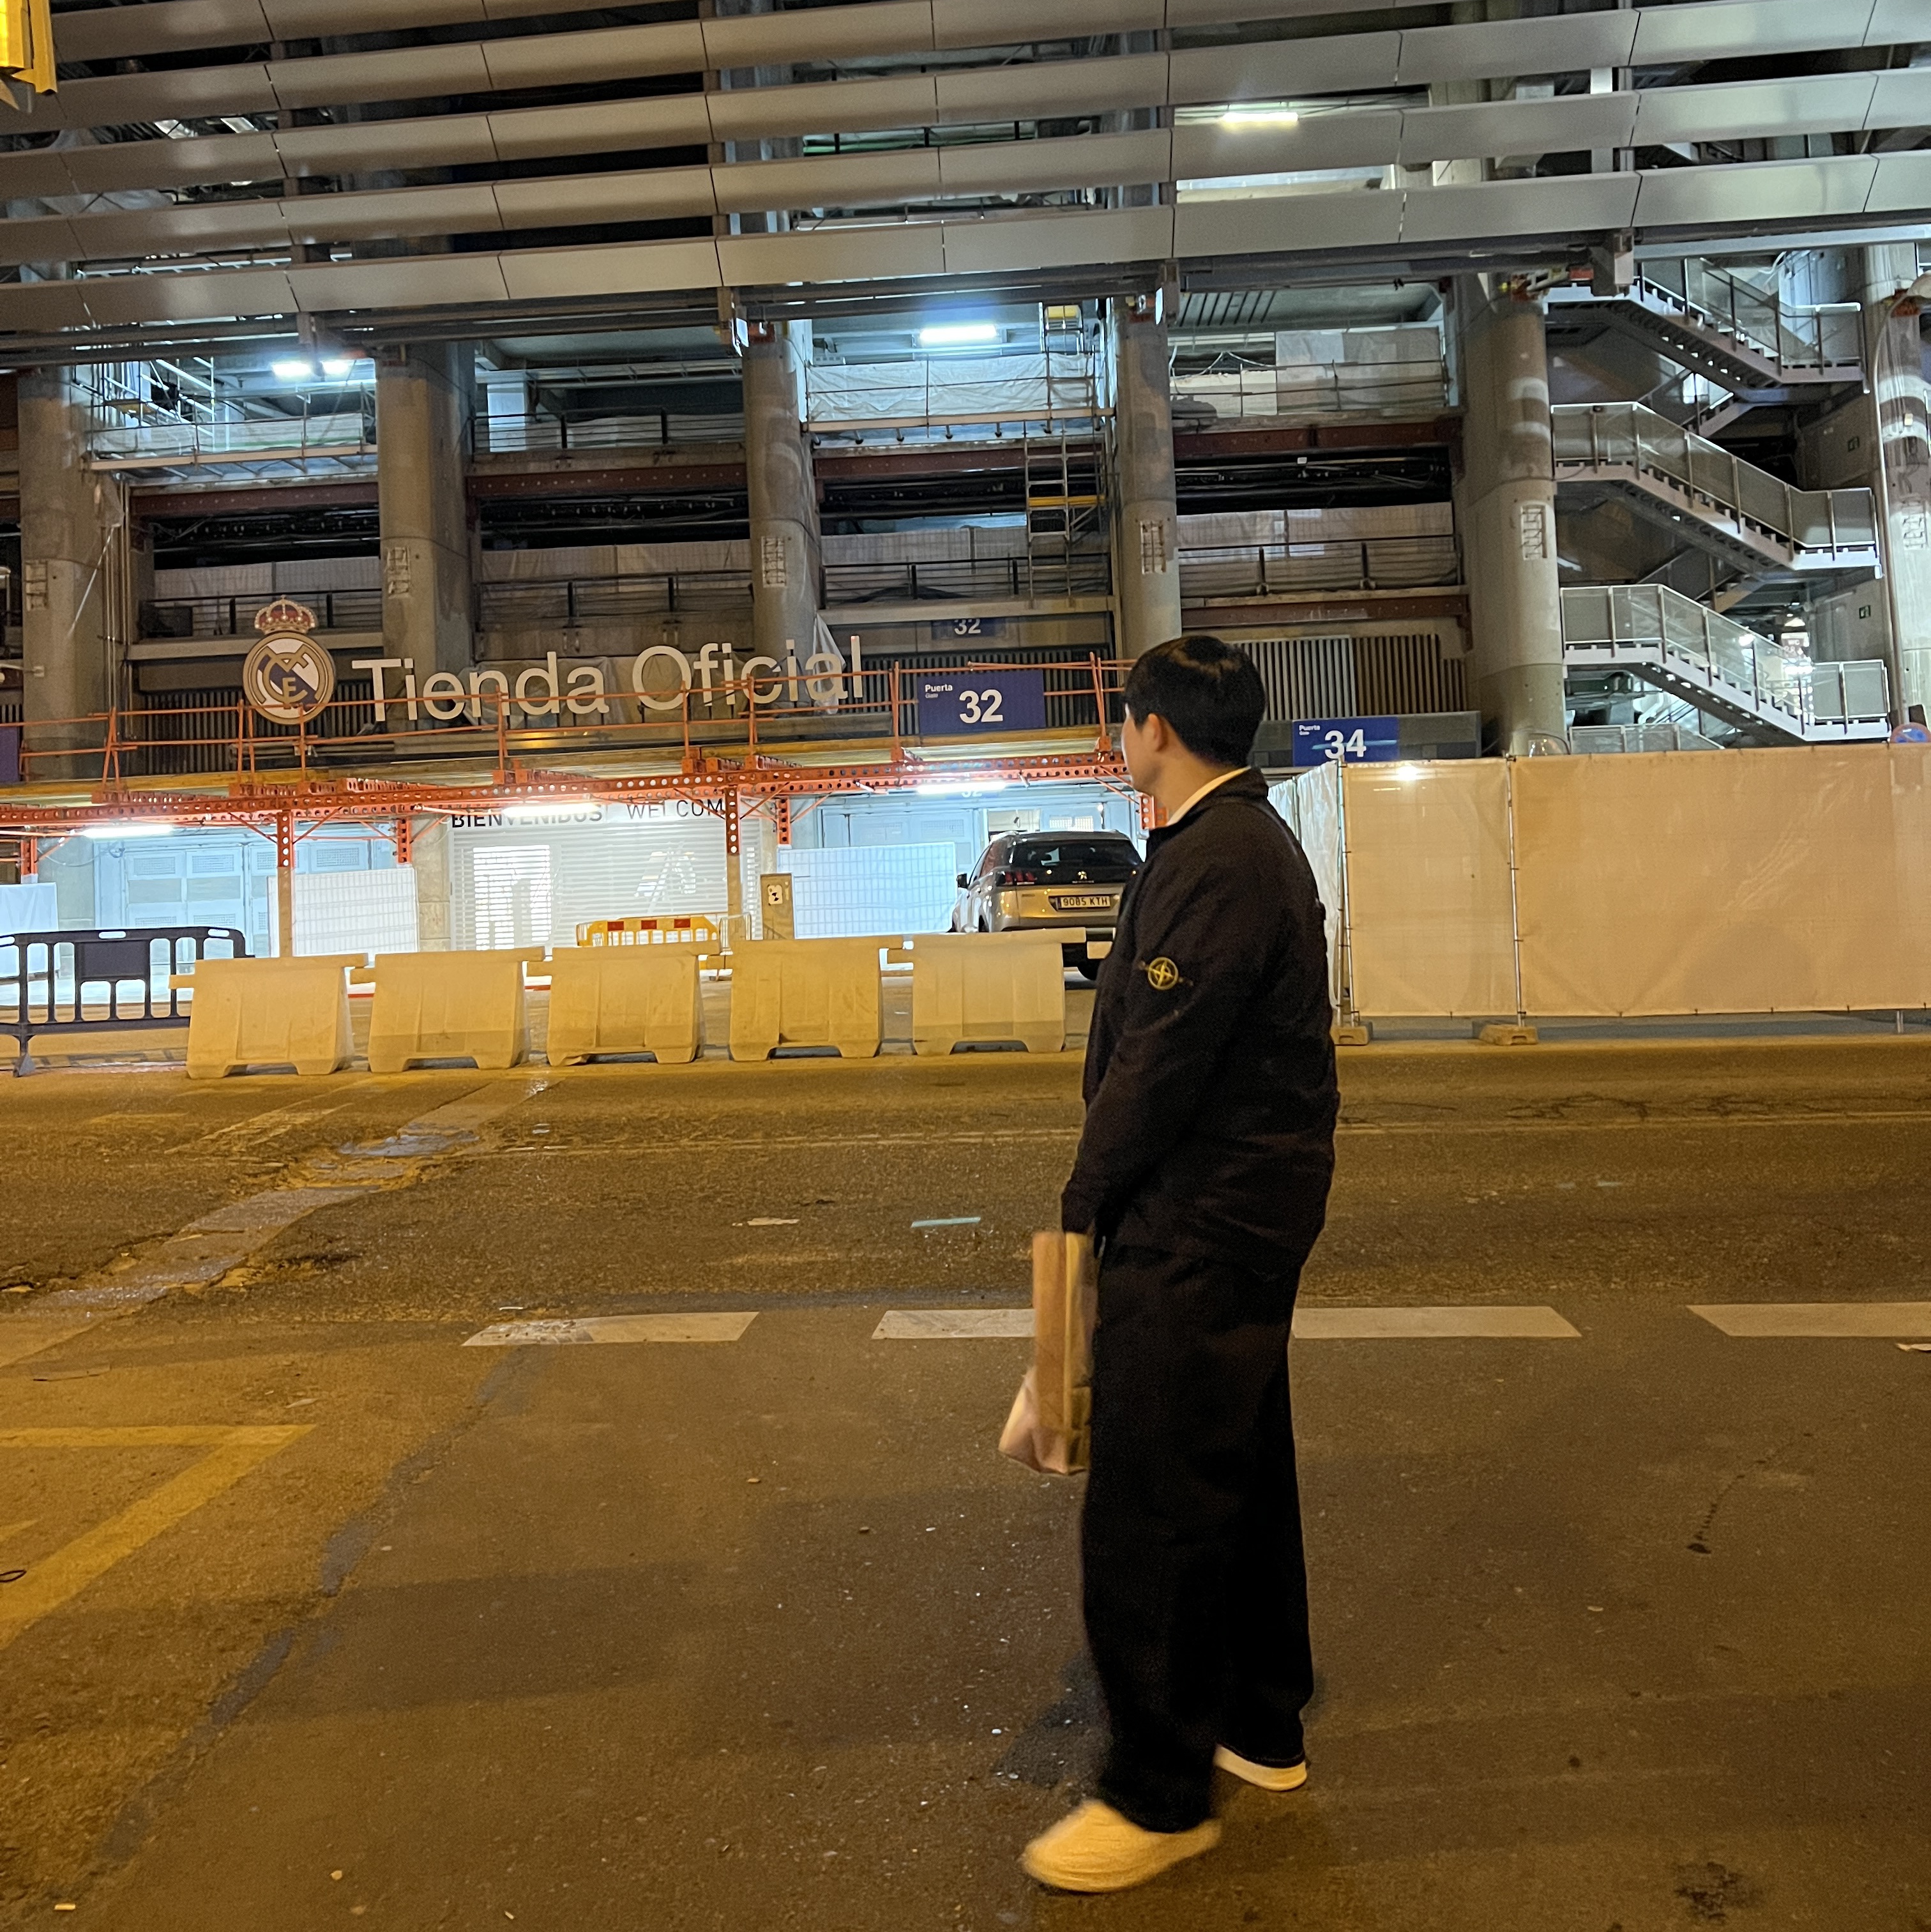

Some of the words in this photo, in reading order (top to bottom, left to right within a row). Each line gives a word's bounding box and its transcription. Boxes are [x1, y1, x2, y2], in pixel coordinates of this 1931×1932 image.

[954, 618, 981, 635] 32
[352, 651, 610, 722] Tienda
[632, 635, 863, 710] Oficial
[925, 683, 953, 692] Puerta
[959, 689, 1003, 724] 32
[1324, 729, 1367, 759] 34
[626, 798, 724, 819] WELCOM
[1063, 897, 1087, 906] 9085
[1089, 895, 1107, 906] KTH
